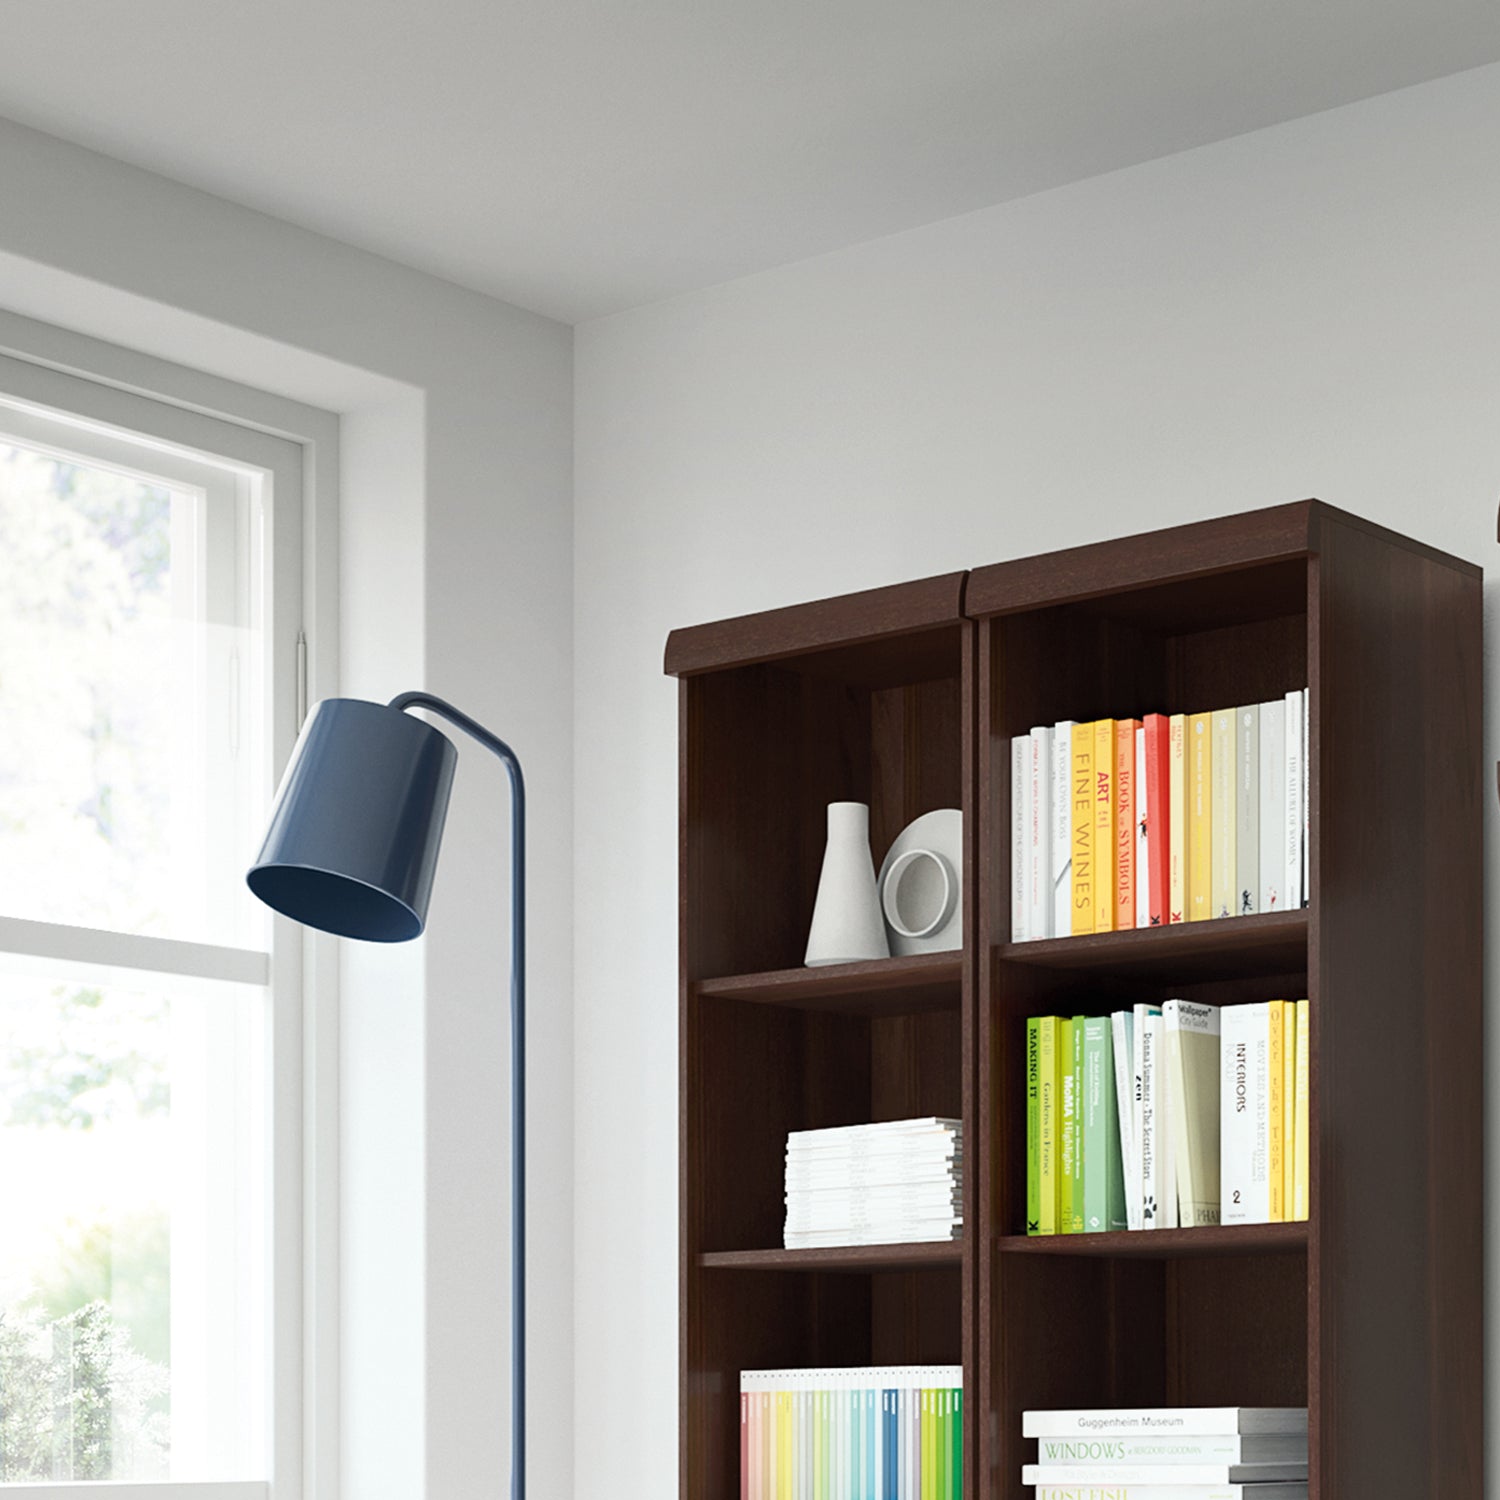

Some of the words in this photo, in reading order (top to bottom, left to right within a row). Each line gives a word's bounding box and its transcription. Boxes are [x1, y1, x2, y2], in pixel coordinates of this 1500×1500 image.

[1074, 753, 1091, 811] FINE
[1096, 771, 1109, 804] ART
[1119, 770, 1130, 814] BOOK
[1074, 822, 1091, 910] WINES
[1119, 829, 1130, 905] SYMBOLS
[1029, 1028, 1038, 1082] MAKING
[1143, 1032, 1152, 1063] Donna
[1029, 1086, 1038, 1100] IT
[1143, 1064, 1152, 1102] Summer
[1236, 1043, 1247, 1113] INTERIORS
[1043, 1082, 1051, 1125] Gardens
[1063, 1075, 1074, 1118] MoMA
[1043, 1128, 1051, 1139] in
[1143, 1109, 1152, 1126] The
[1043, 1141, 1051, 1176] France
[1063, 1121, 1074, 1176] Highlights
[1143, 1127, 1152, 1157] Secret
[1143, 1157, 1152, 1180] Story
[1232, 1190, 1241, 1204] 2
[1077, 1417, 1139, 1430] Guggenheim
[1141, 1417, 1184, 1427] Museum
[1044, 1441, 1126, 1460] WINDOWS
